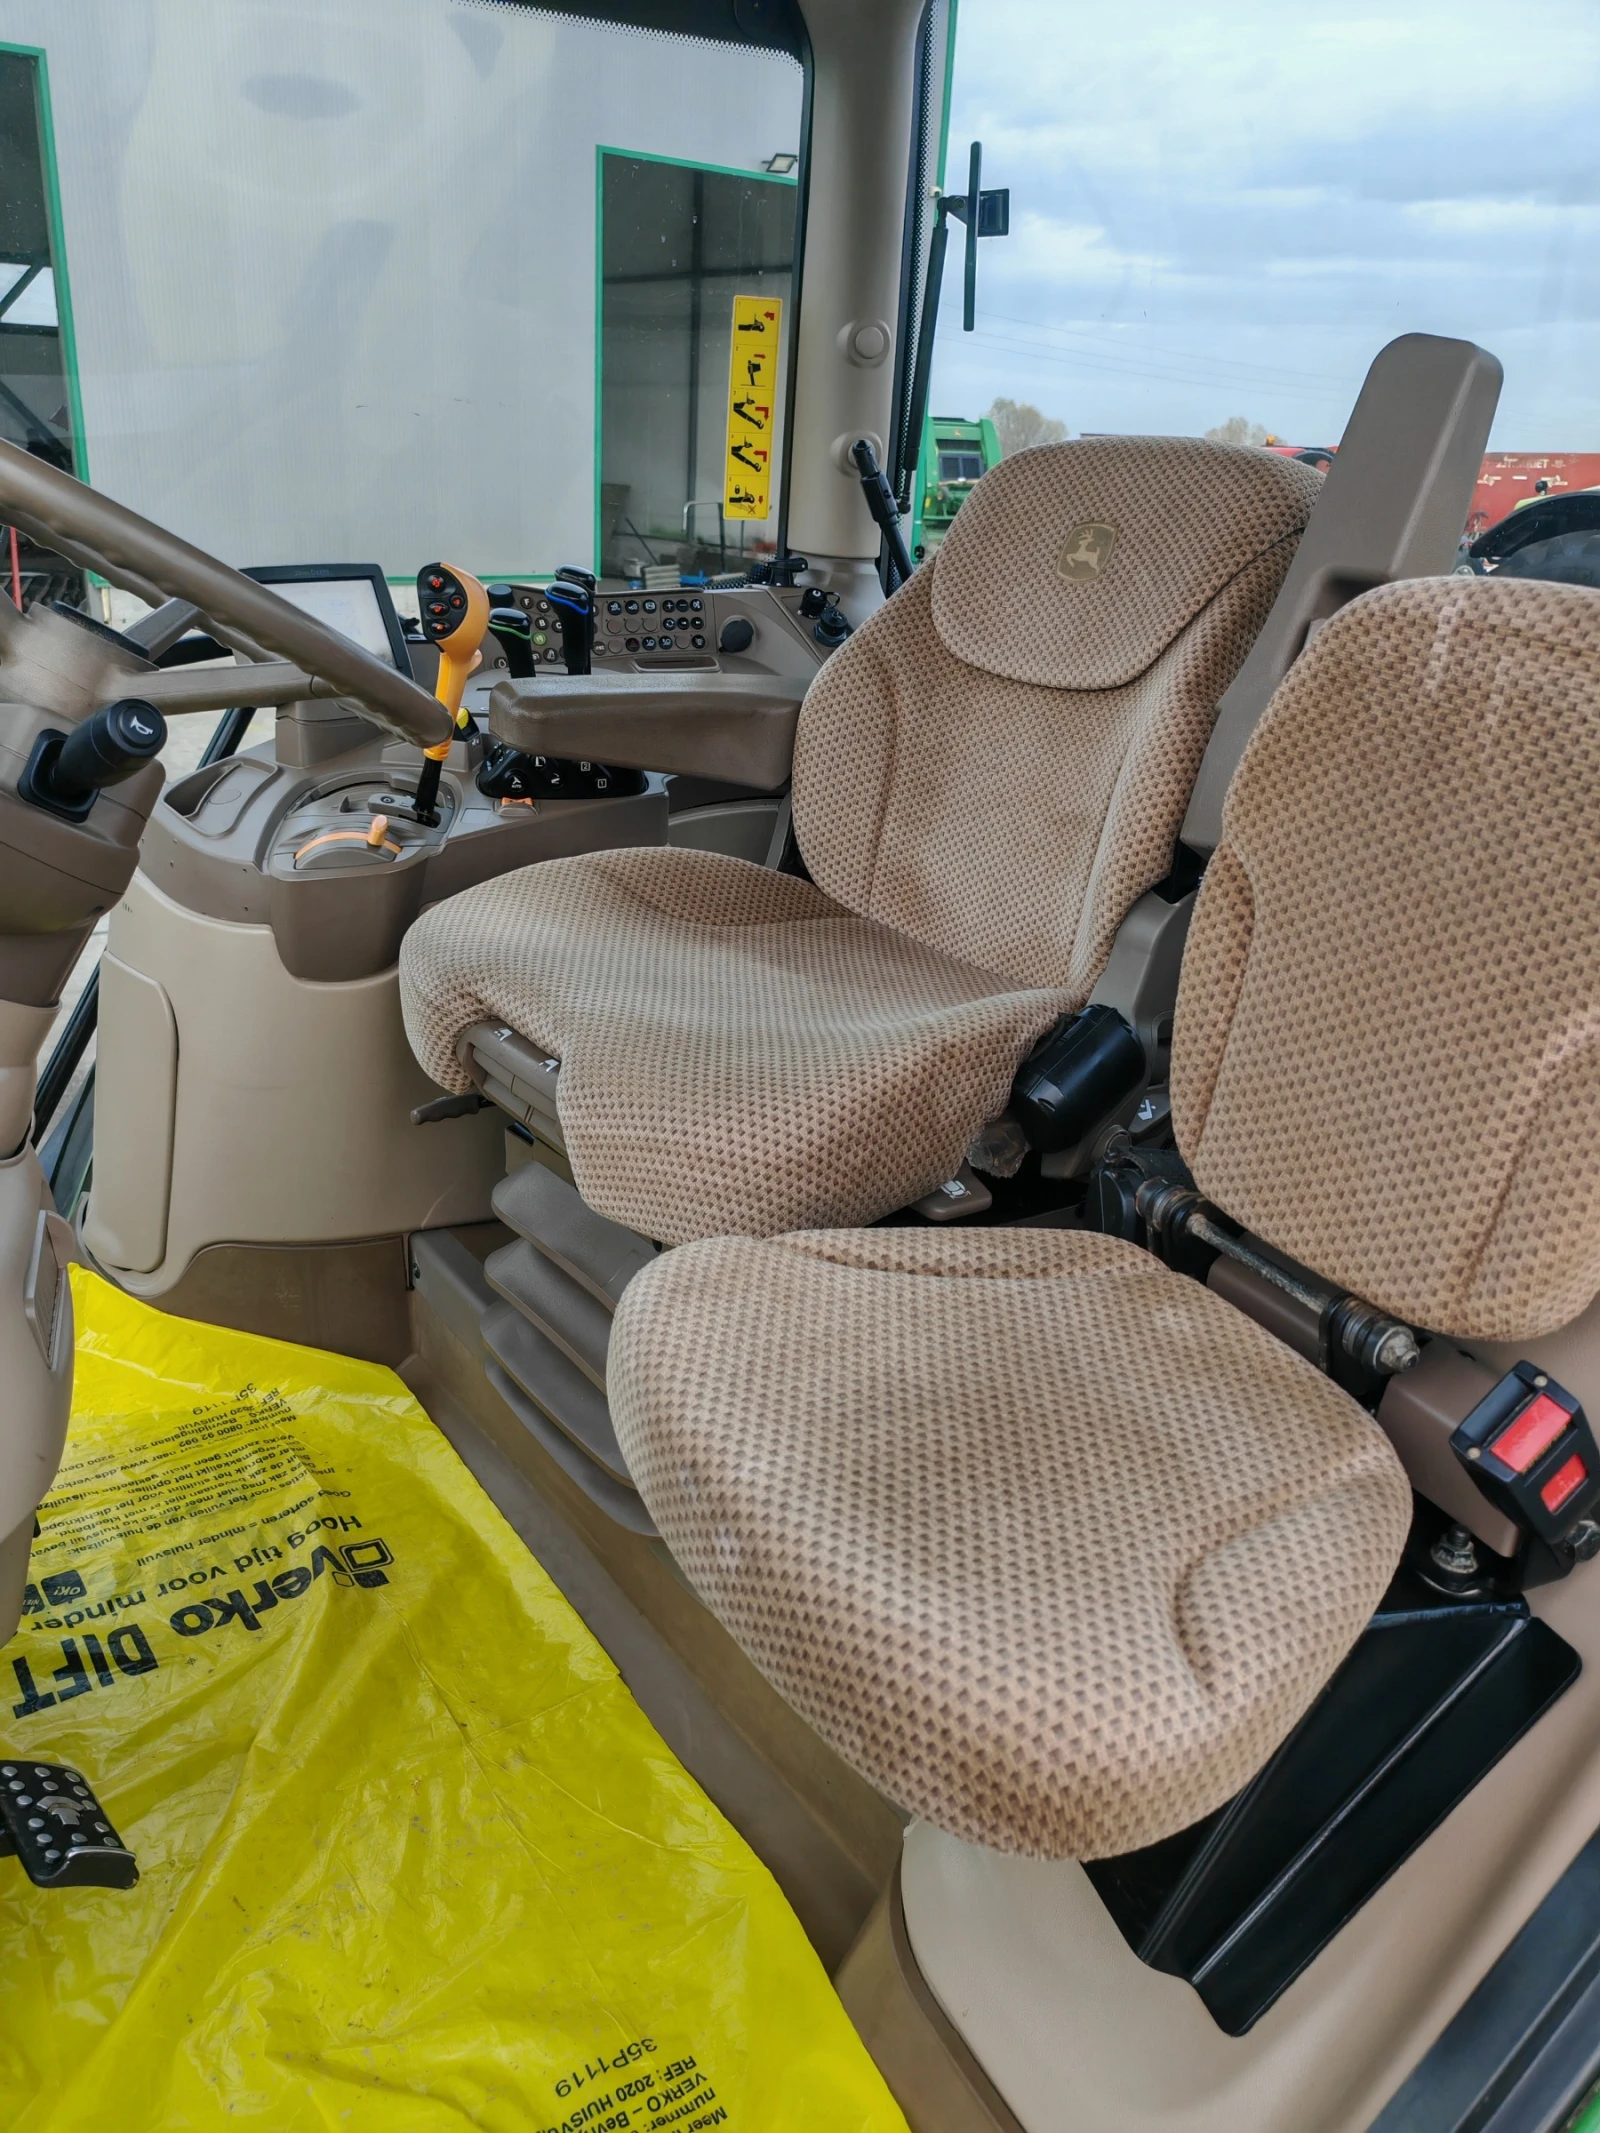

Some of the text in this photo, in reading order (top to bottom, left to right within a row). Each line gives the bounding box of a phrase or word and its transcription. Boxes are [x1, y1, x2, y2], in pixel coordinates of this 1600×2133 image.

[30, 1514, 363, 1634] Hoog tijd voor minder
[53, 1585, 81, 1597] OK!
[11, 1545, 346, 1719] verko DIFT
[554, 2038, 658, 2098] 35P1119
[615, 2073, 656, 2103] 2020
[655, 2055, 697, 2081] REF:
[643, 2086, 716, 2133] nummer:
[646, 2072, 708, 2113] VERKO
